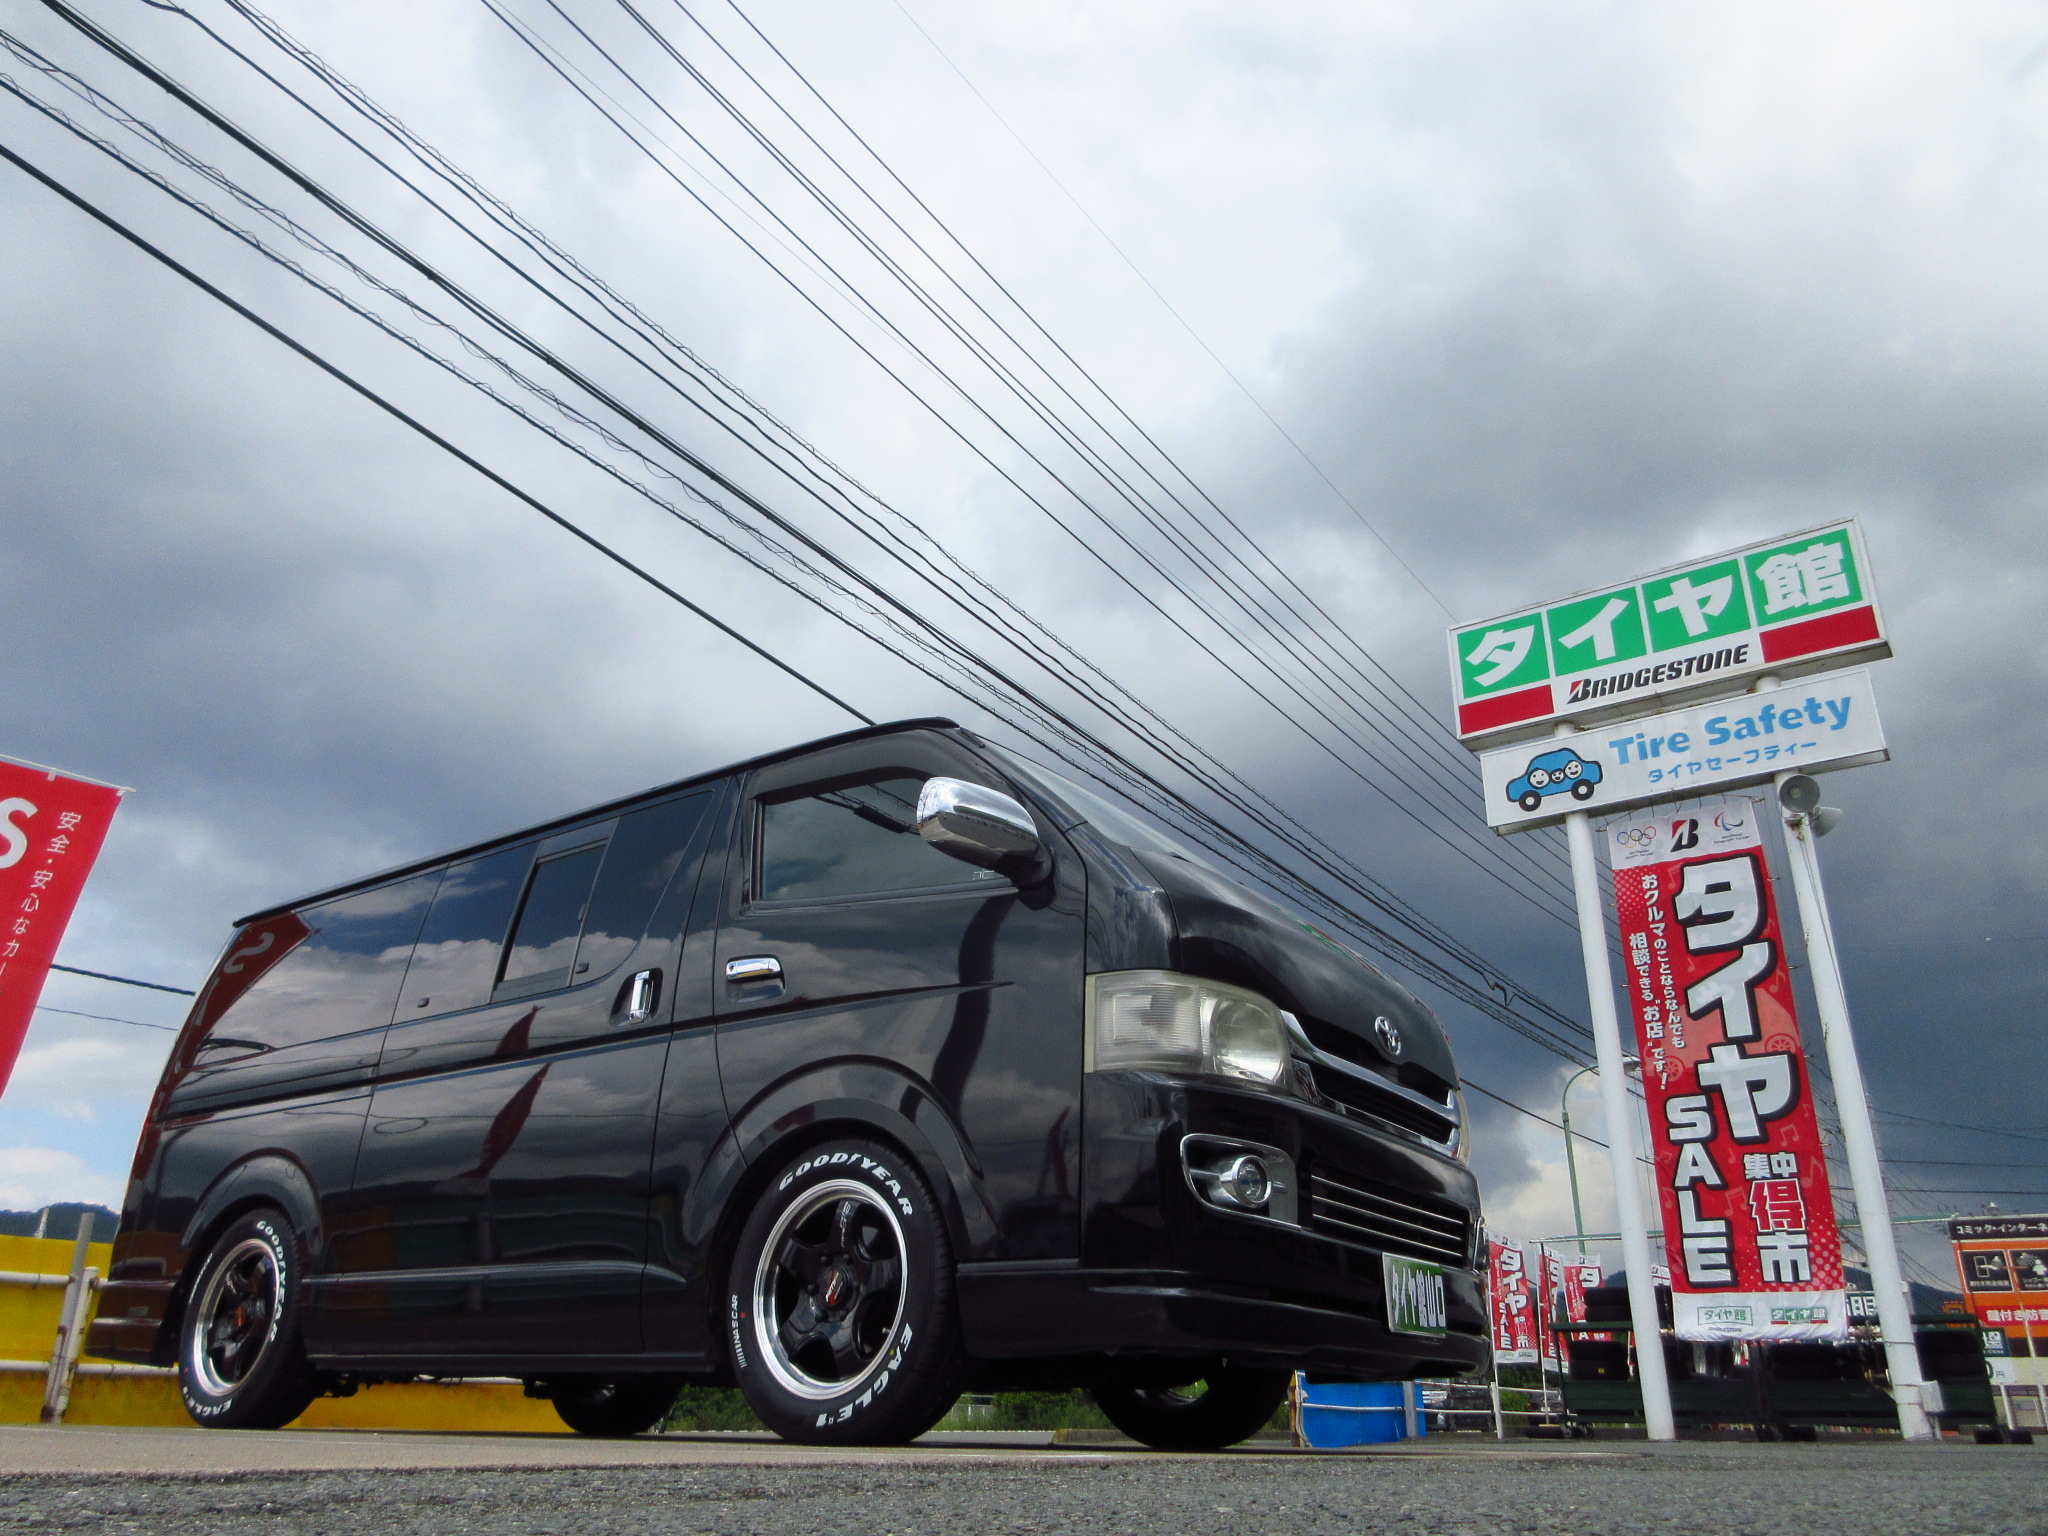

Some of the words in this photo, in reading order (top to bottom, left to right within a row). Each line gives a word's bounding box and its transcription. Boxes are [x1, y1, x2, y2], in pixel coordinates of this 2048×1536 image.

[1465, 542, 1852, 687] タイヤ館
[1567, 643, 1750, 704] BRIDGESTONE
[1608, 732, 1691, 766] Tire
[1703, 695, 1852, 746] Safety
[1647, 741, 1818, 784] タイヤセーフティー
[1641, 874, 1686, 1049] おクルマのことならなんでも
[1675, 855, 1791, 1139] タイヤ
[1666, 1094, 1732, 1282] SALE
[1500, 1248, 1528, 1316] タイヤ
[1704, 1308, 1746, 1321] タイヤ館
[731, 1294, 741, 1345] NASCAR
[1499, 1302, 1513, 1349] SALE
[837, 1322, 913, 1422] EAGLE
